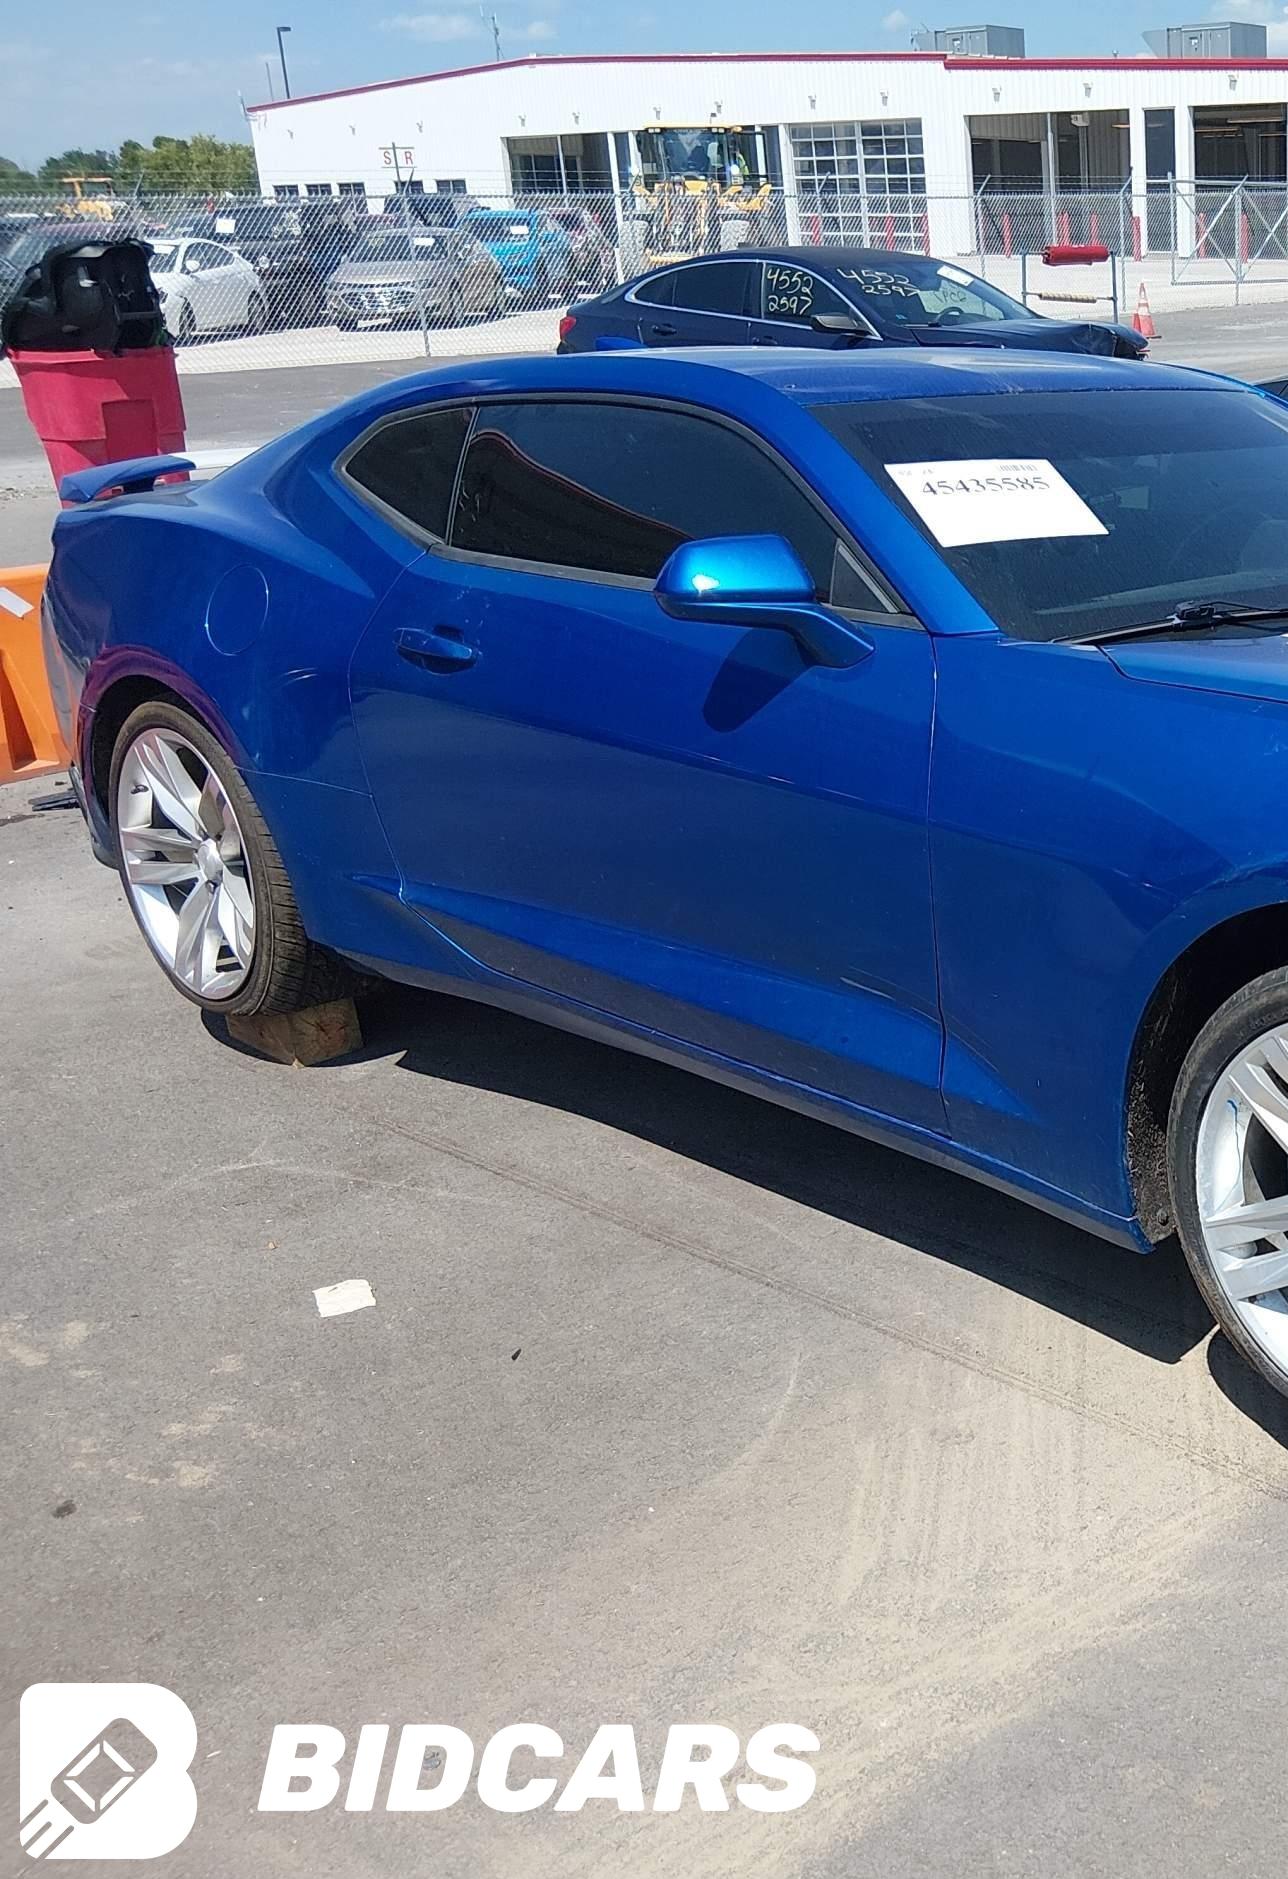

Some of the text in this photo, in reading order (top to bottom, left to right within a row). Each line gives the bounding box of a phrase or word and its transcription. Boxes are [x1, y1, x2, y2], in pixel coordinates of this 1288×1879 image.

[404, 150, 414, 165] R
[767, 268, 814, 298] 4552
[836, 268, 914, 288] 4552
[862, 284, 920, 298] 2597
[768, 295, 812, 315] 2597
[923, 477, 1050, 495] 45435585
